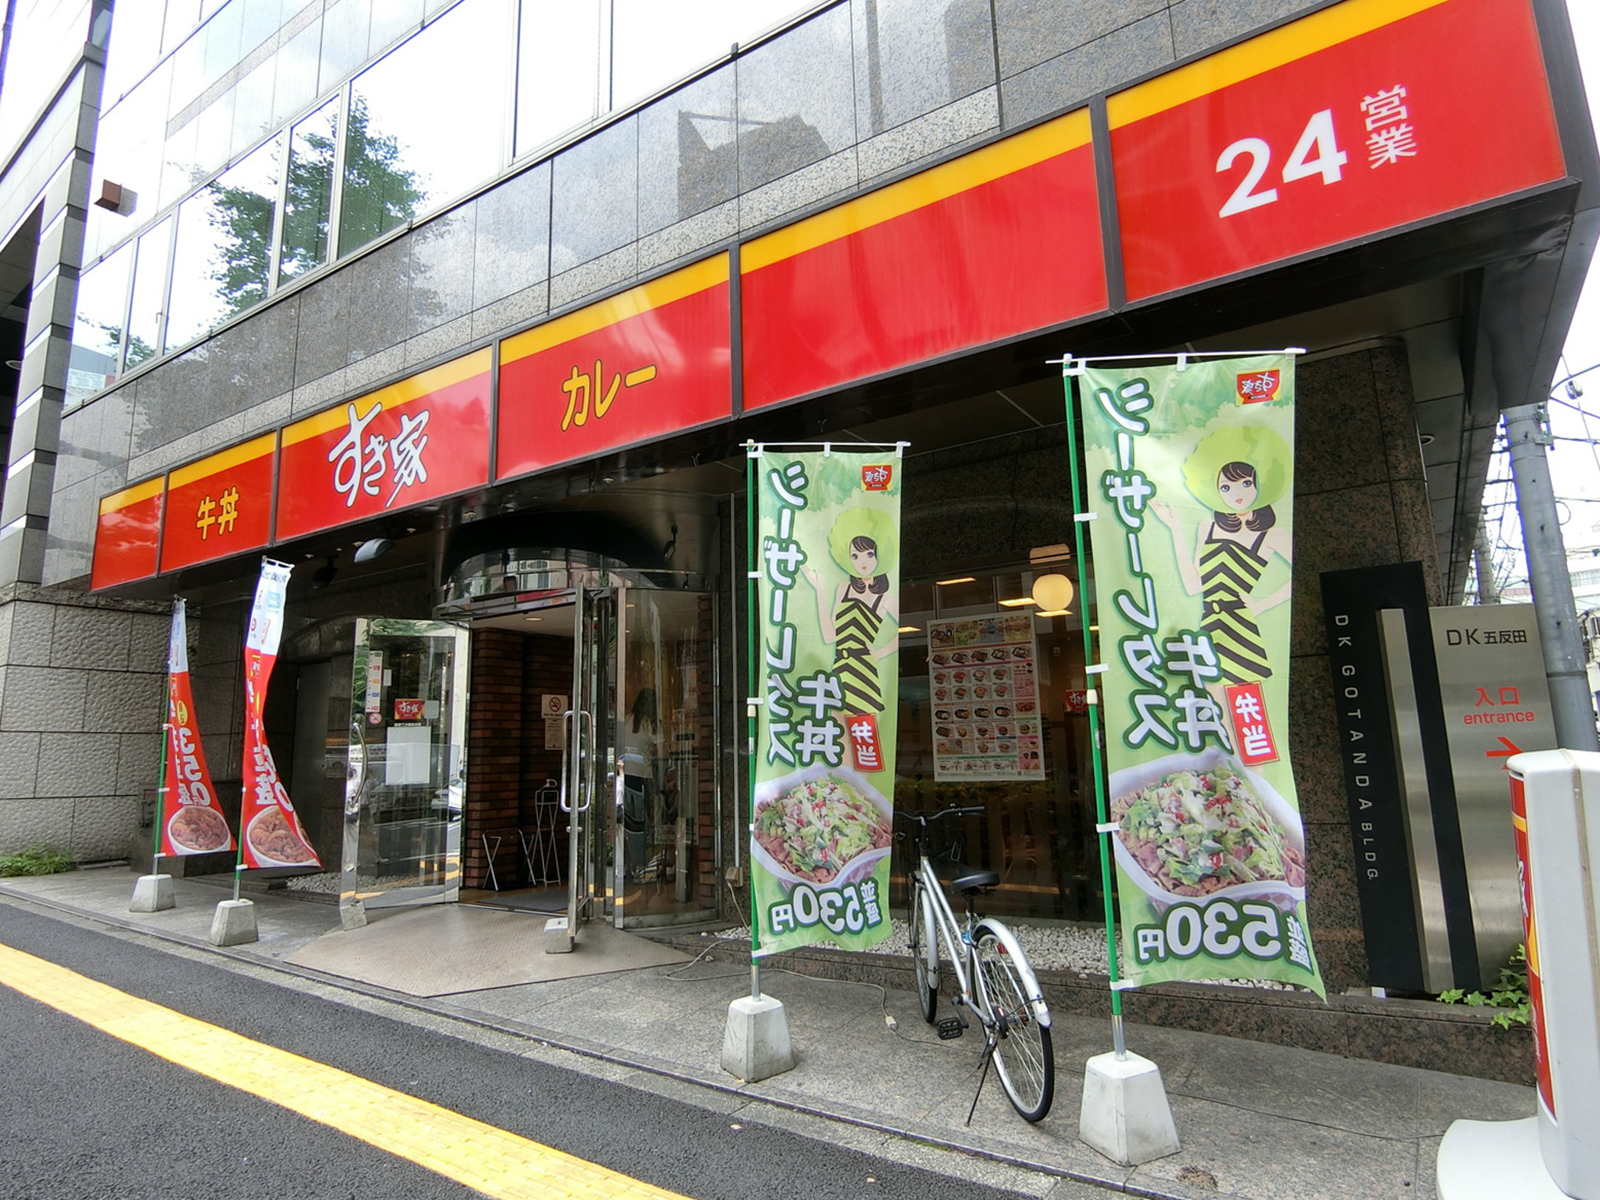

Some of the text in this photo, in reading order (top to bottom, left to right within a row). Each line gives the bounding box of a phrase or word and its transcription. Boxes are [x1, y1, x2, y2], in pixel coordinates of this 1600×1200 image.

[1215, 84, 1417, 218] 24 営業
[561, 359, 657, 432] カレー
[328, 402, 430, 508] すき家
[196, 486, 239, 541] 牛丼
[1463, 710, 1535, 726] entrance
[1474, 686, 1520, 707] 入口
[1341, 664, 1373, 811] GOTANDA
